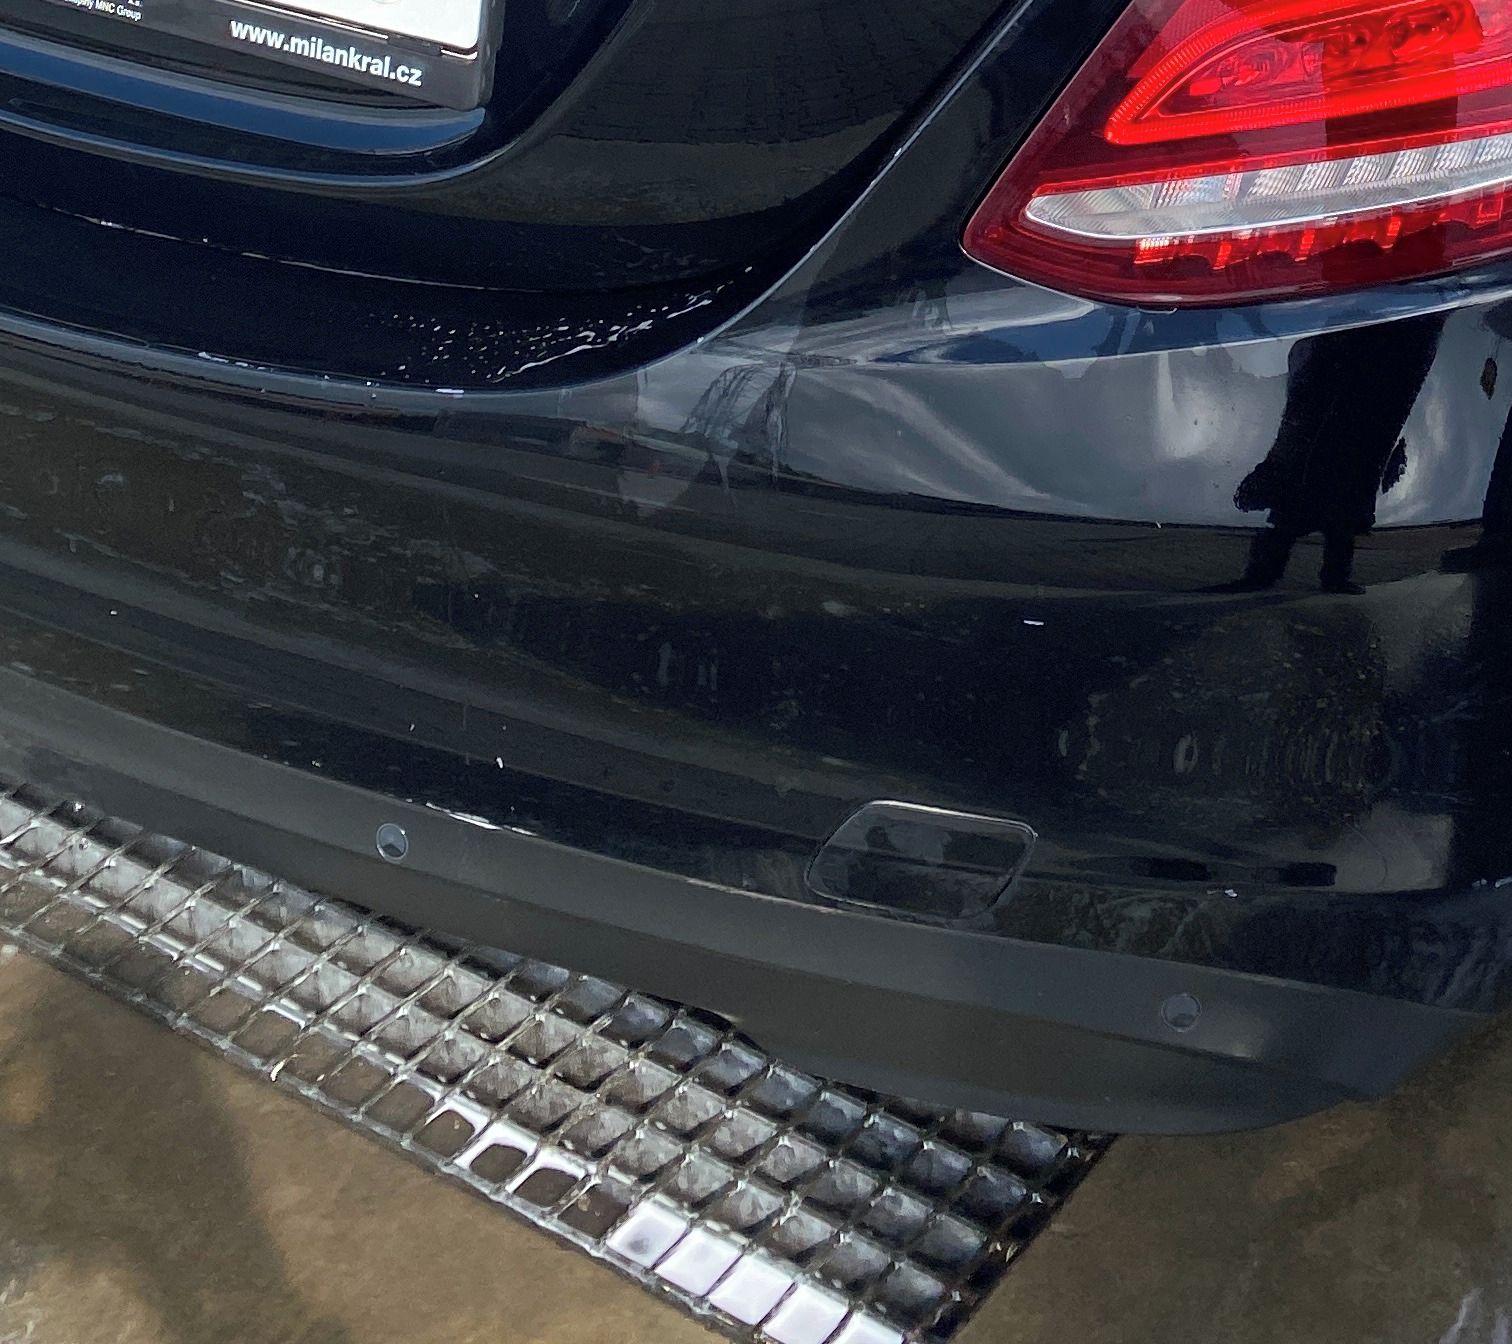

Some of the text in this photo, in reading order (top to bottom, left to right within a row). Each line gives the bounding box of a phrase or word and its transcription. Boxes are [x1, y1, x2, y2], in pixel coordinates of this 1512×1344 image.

[95, 0, 115, 14] MNC
[116, 5, 142, 22] Group
[230, 20, 422, 86] www.milankral.cz
